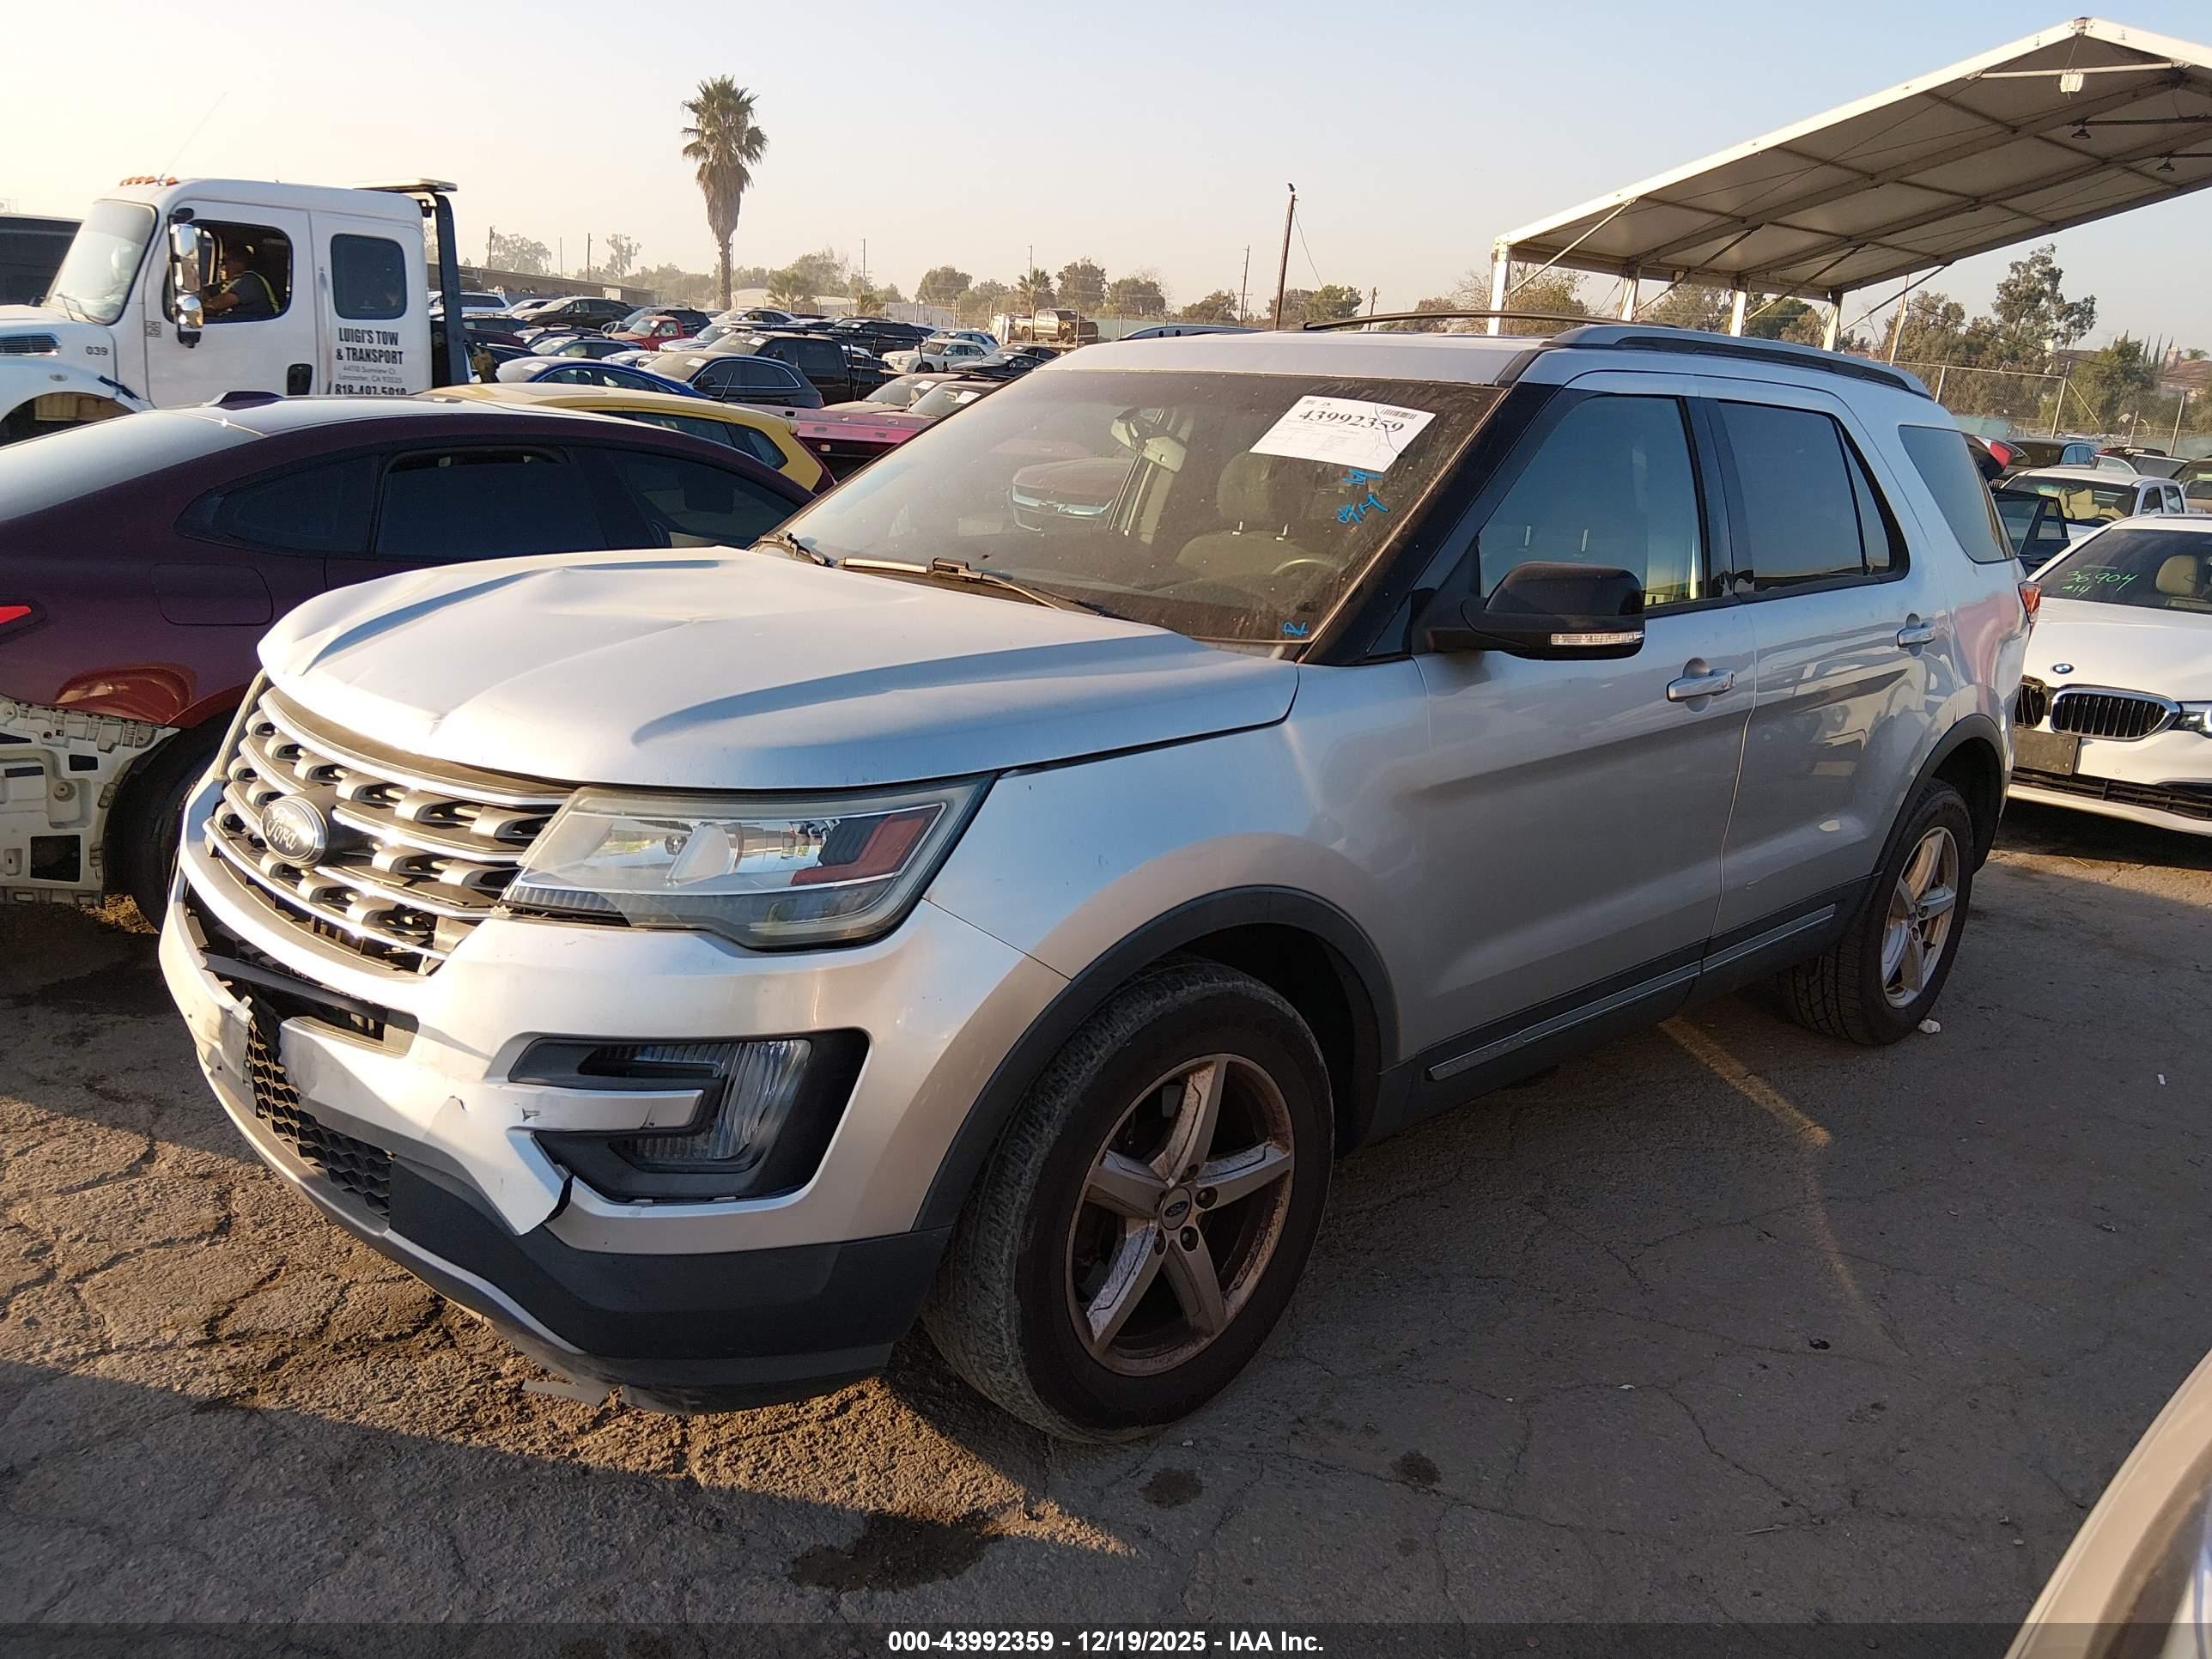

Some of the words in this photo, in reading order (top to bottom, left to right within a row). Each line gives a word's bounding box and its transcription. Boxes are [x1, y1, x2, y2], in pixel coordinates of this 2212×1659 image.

[338, 327, 374, 344] LUIGI'S
[375, 331, 399, 346] TOW
[86, 345, 108, 356] 039
[336, 348, 343, 361] &
[345, 347, 404, 365] TRANSPORT
[1298, 410, 1405, 433] 43992359
